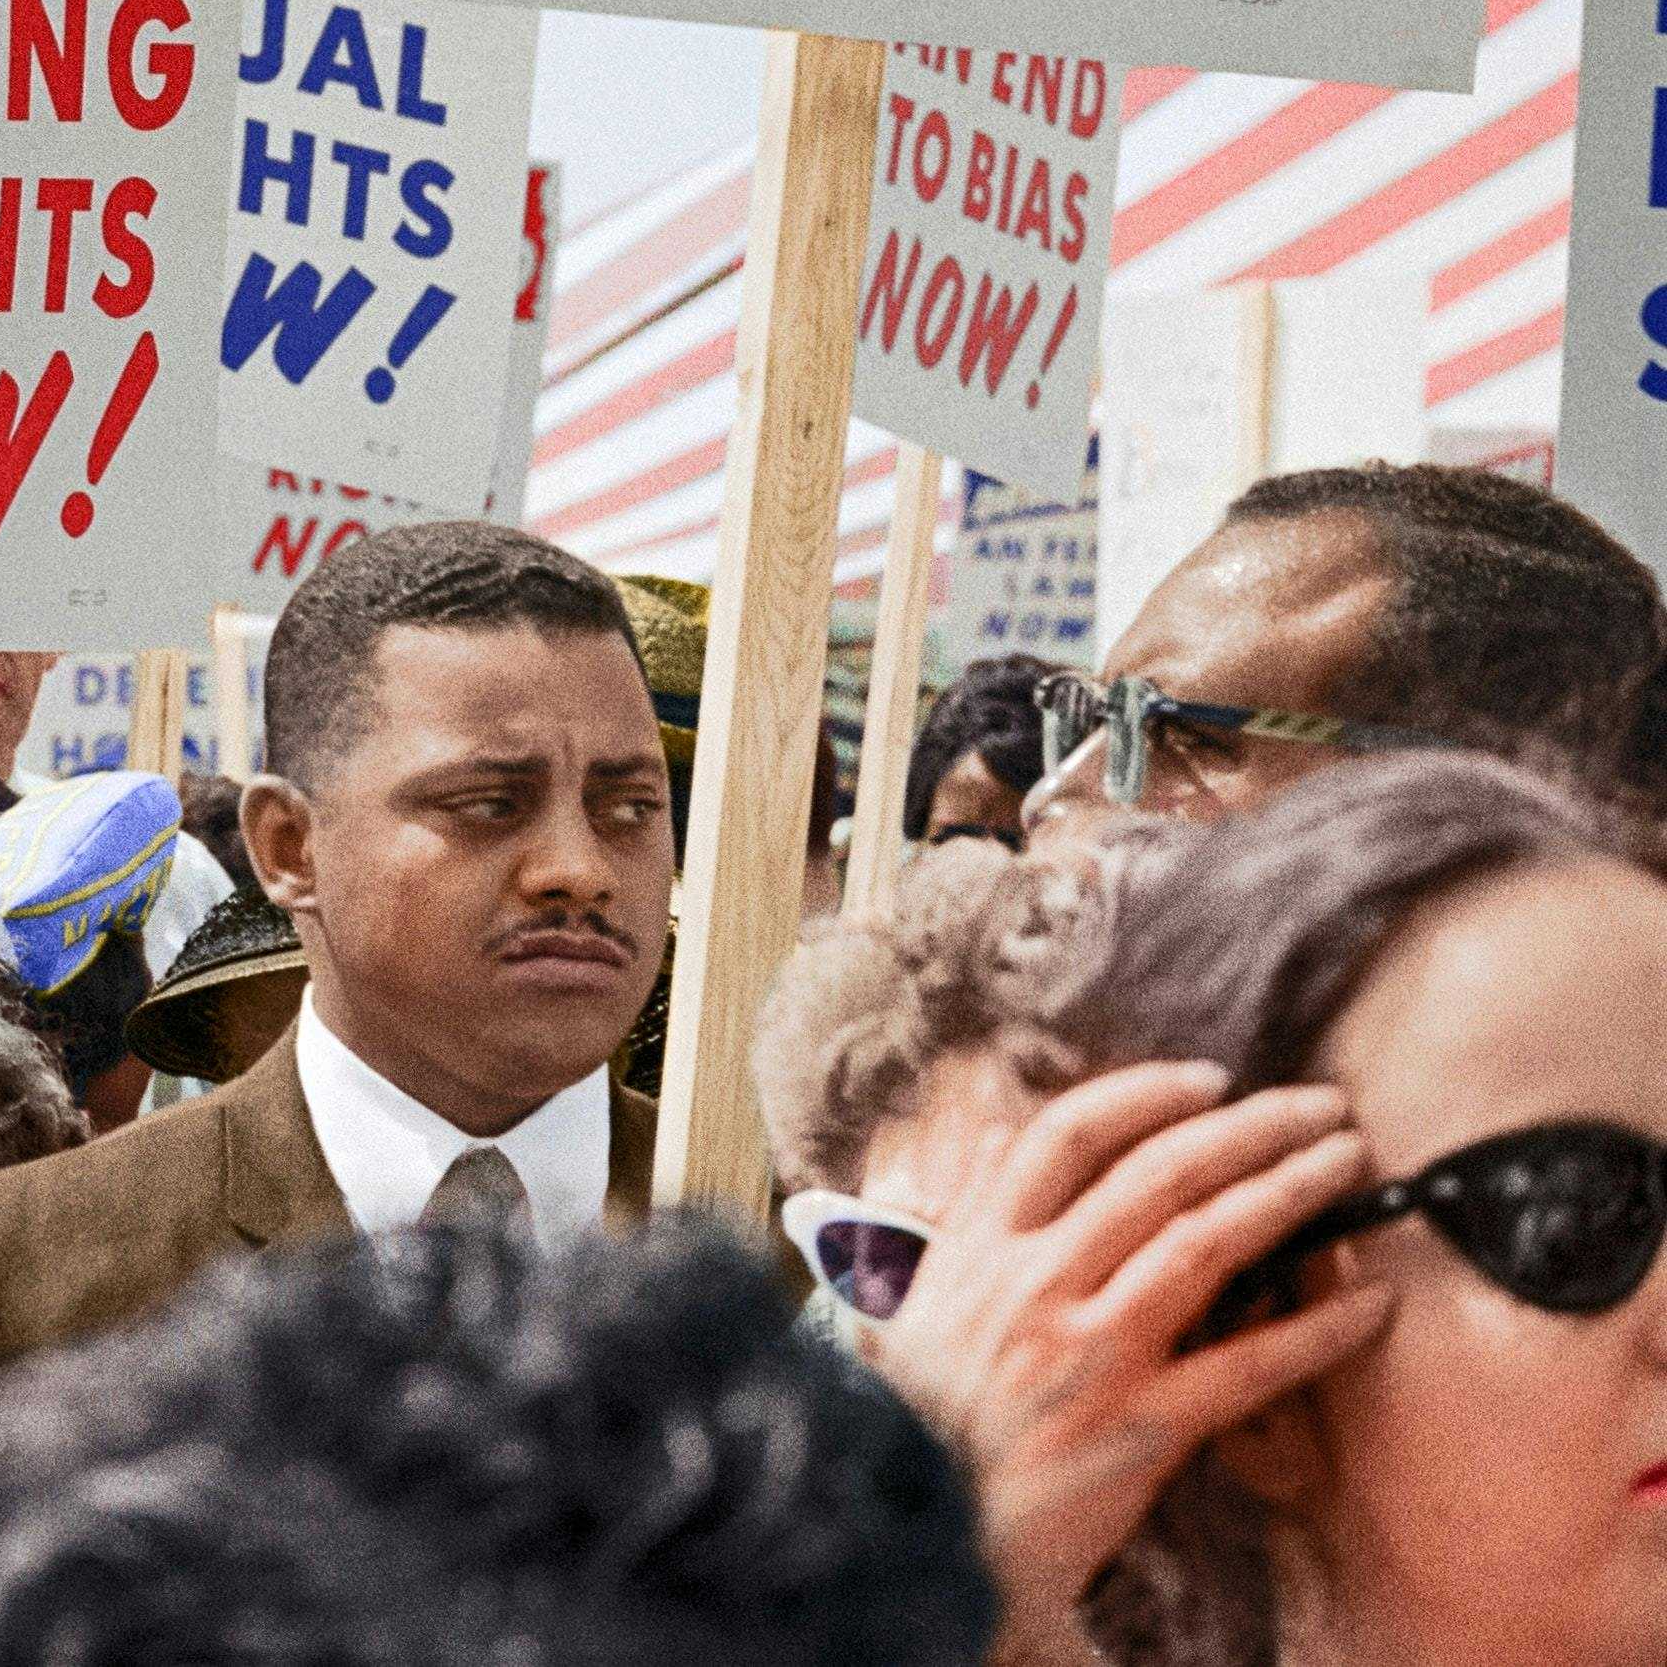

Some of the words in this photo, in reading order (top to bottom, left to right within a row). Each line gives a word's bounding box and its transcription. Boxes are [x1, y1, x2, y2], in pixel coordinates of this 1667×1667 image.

[990, 51, 1108, 141] END
[239, 120, 453, 258] HTS
[886, 94, 952, 203] TO
[962, 131, 1090, 264] BIAS
[220, 254, 453, 403] W!
[858, 229, 1078, 411] NOW!
